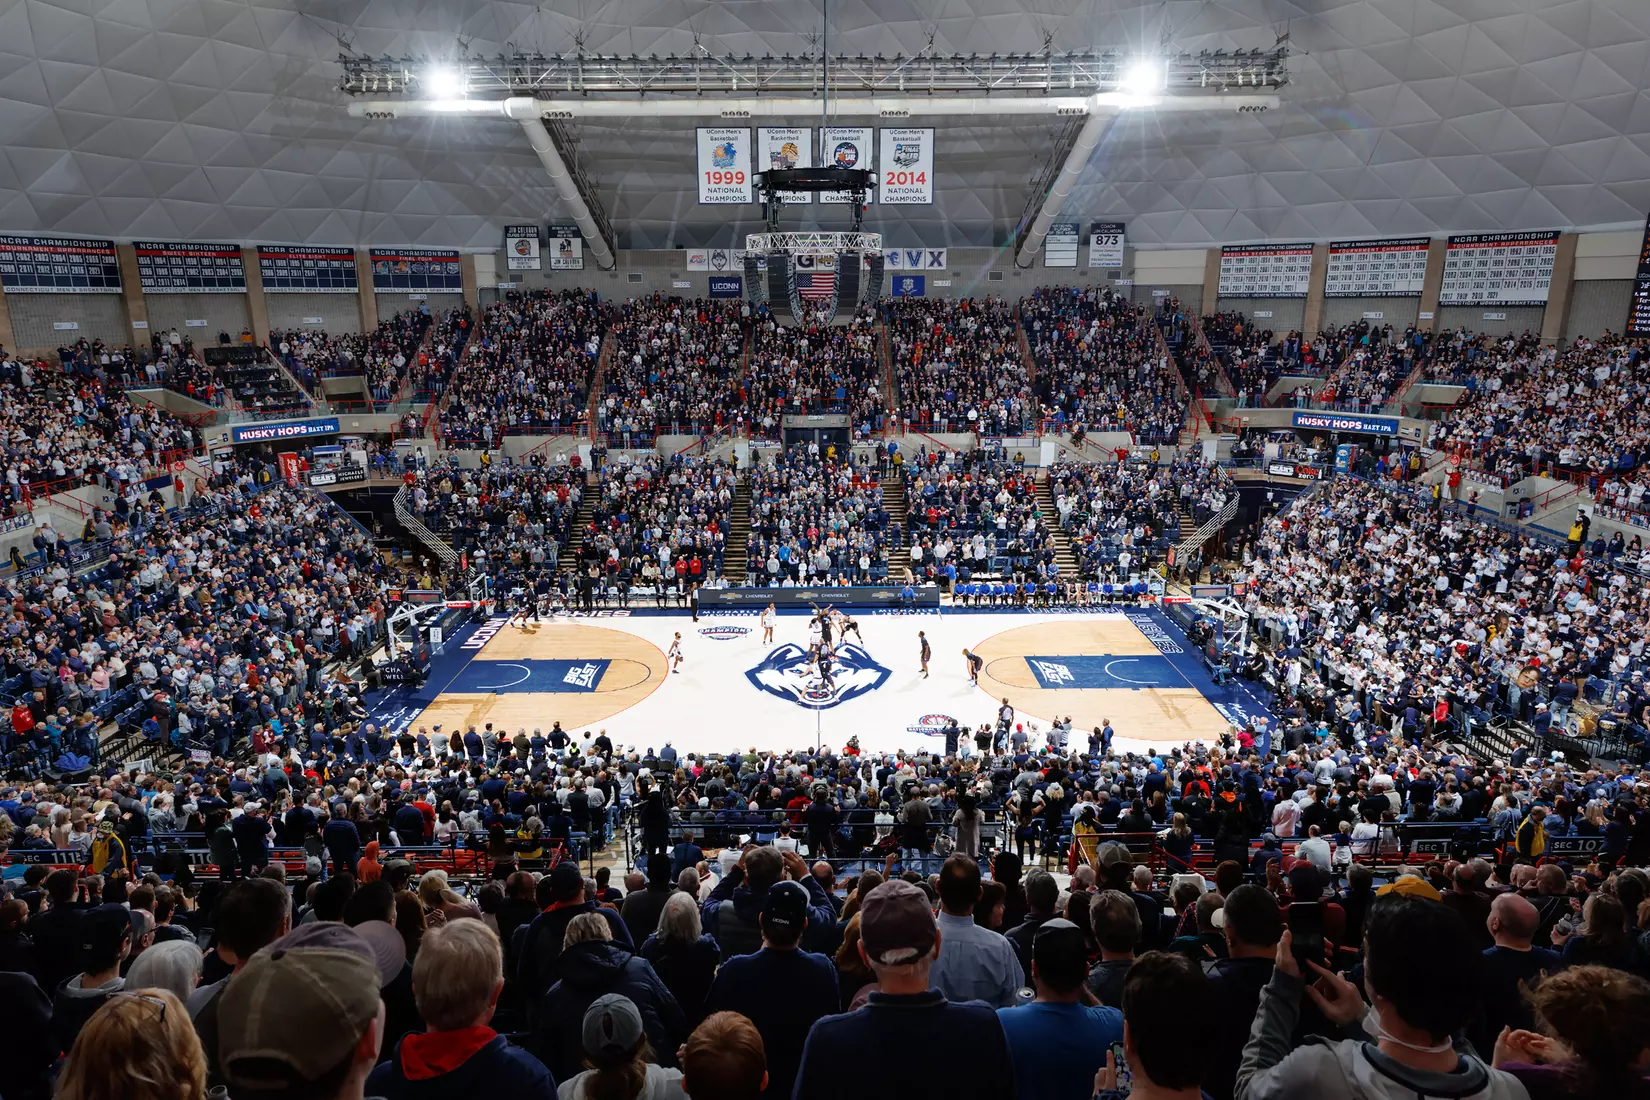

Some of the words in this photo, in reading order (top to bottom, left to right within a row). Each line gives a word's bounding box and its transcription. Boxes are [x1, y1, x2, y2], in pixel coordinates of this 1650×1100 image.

[705, 171, 745, 184] 1999
[886, 172, 926, 185] 2014
[1096, 235, 1118, 245] 873
[1482, 232, 1553, 241] CHAMPIONSHIP
[34, 239, 108, 248] CHAMPIONSHIP
[907, 252, 922, 266] V
[928, 252, 944, 267] X
[1298, 417, 1331, 427] HUSKY
[1333, 420, 1362, 429] HOPS
[240, 429, 275, 440] HUSKY
[278, 426, 307, 436] HOPS
[1295, 466, 1319, 475] Coke
[460, 618, 509, 649] UCONN
[563, 666, 582, 684] BIG
[575, 663, 598, 687] EAST
[1042, 661, 1063, 685] EAST
[1059, 664, 1074, 680] BIG
[1578, 840, 1604, 851] 107
[52, 853, 75, 864] 111
